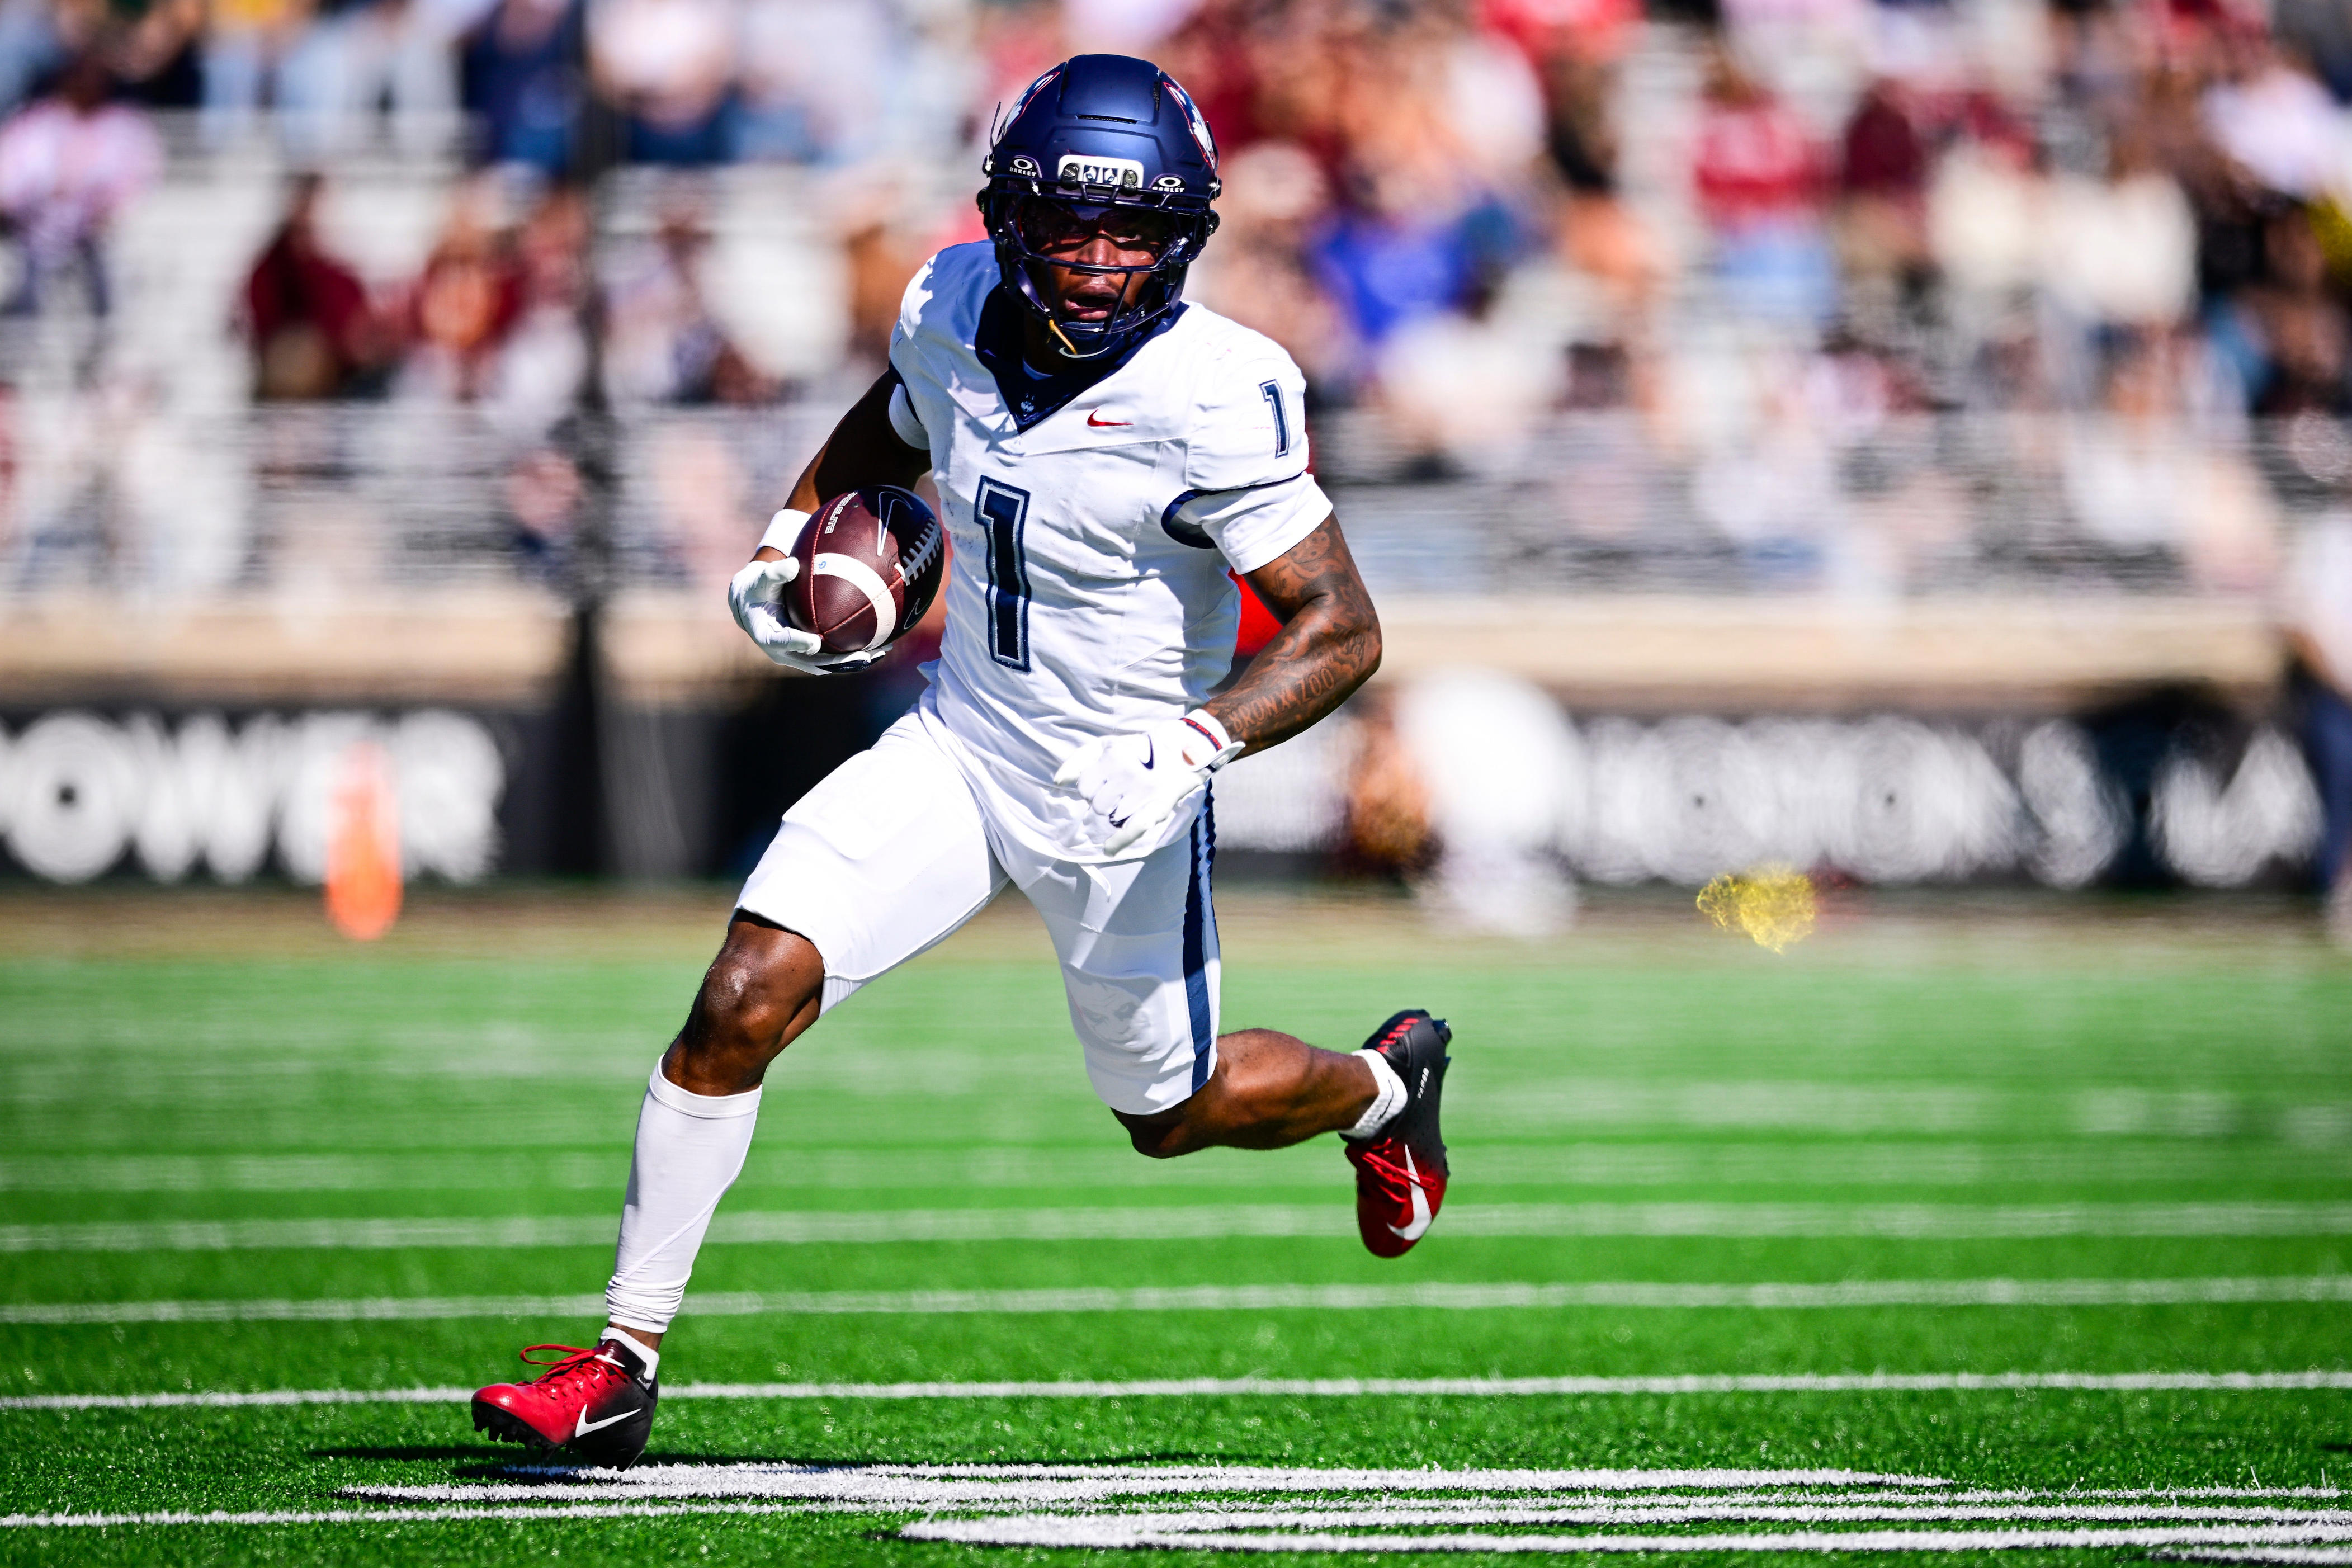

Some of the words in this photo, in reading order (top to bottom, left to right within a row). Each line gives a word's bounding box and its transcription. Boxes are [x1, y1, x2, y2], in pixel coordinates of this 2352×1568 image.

[1009, 167, 1037, 177] OAKLEY
[1258, 379, 1290, 460] 1
[824, 506, 844, 535] ELITE
[974, 475, 1032, 674] 1
[1228, 688, 1292, 733] BRONX
[1296, 667, 1335, 703] ZOO
